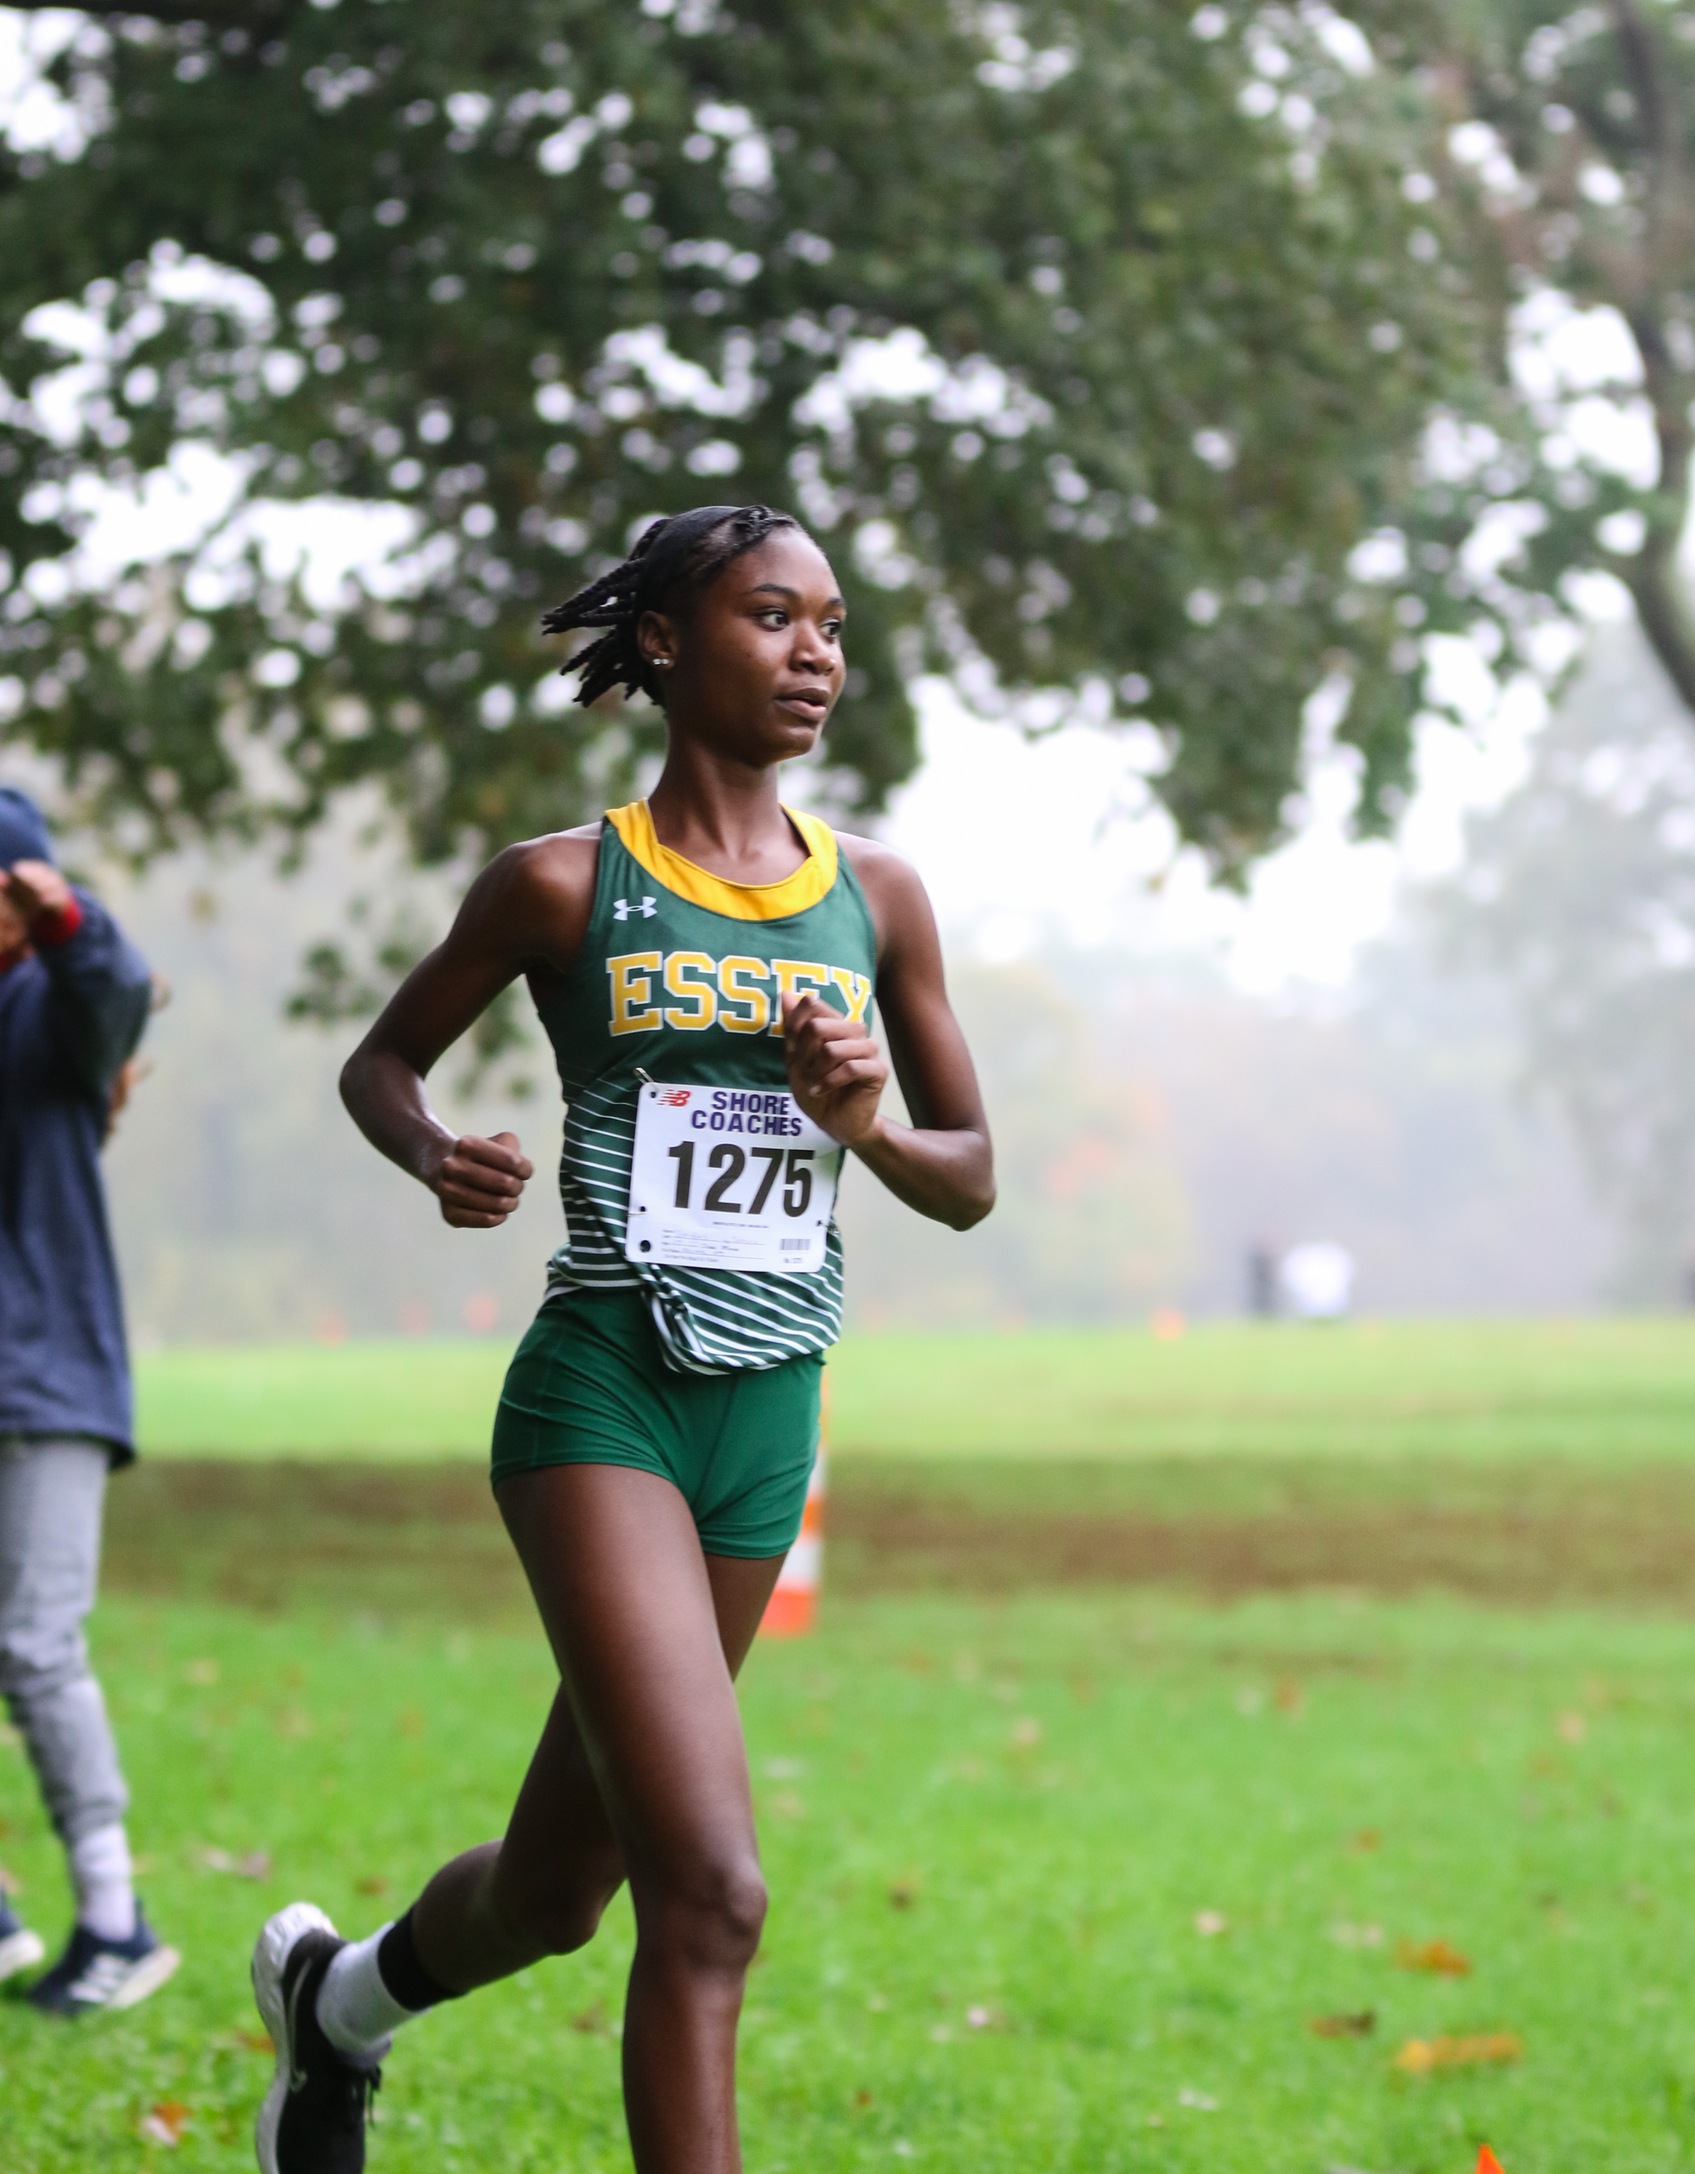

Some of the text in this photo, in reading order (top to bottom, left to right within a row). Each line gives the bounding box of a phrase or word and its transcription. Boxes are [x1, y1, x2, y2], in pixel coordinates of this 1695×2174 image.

[711, 1091, 791, 1116] SHORE
[691, 1110, 803, 1137] COACHES
[667, 1141, 815, 1218] 1275
